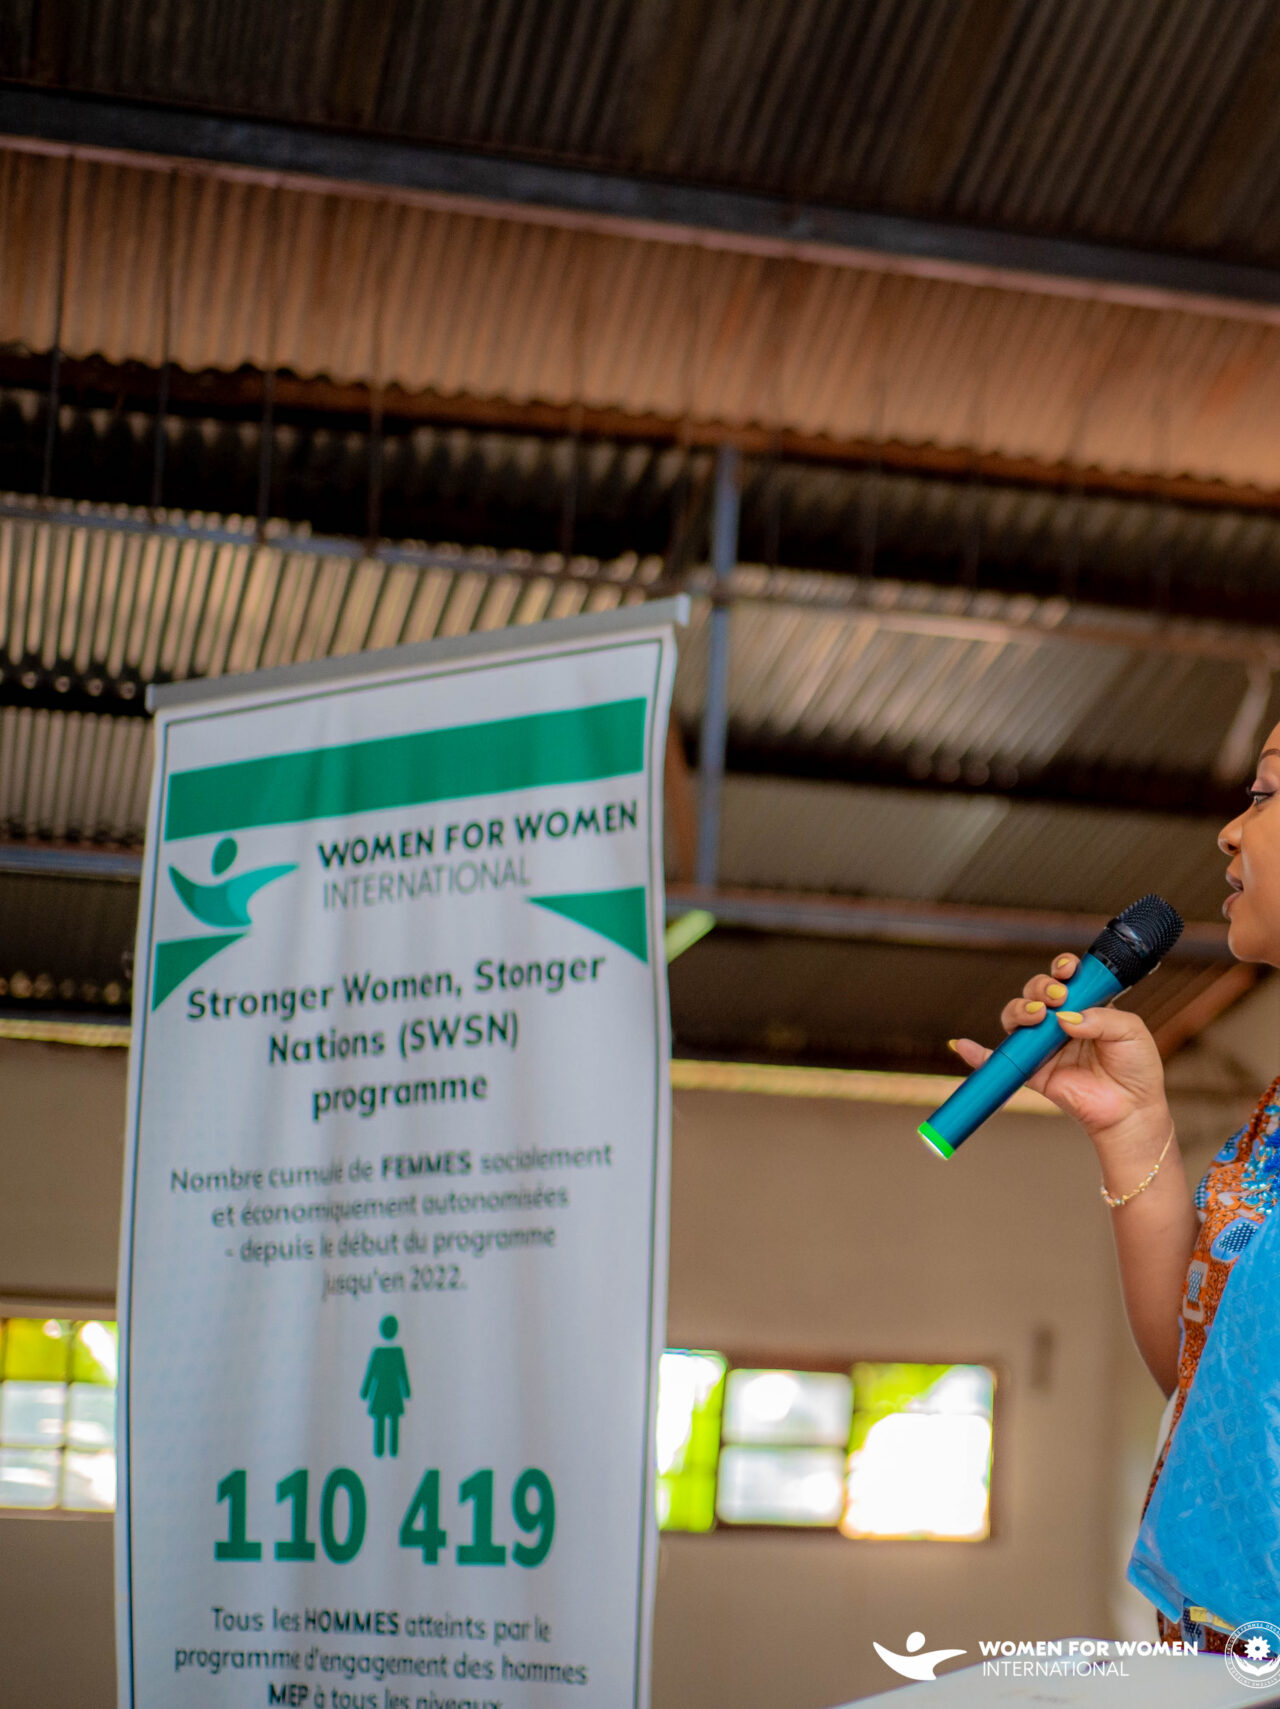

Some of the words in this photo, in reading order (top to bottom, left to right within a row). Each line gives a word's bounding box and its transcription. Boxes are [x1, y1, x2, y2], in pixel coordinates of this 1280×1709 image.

[319, 826, 434, 868] WOMEN
[445, 820, 503, 854] FOR
[516, 801, 638, 844] WOMEN
[322, 856, 530, 911] INTERNATIONAL
[187, 984, 334, 1023] Stronger
[342, 970, 463, 1004] Women,
[476, 953, 606, 994] Stonger
[268, 1027, 385, 1065] Nations
[399, 1012, 518, 1060] (SWSN)
[312, 1074, 488, 1121] programme
[171, 1165, 263, 1192] Nombre
[348, 1156, 374, 1183] de
[381, 1149, 472, 1180] FEMMES
[480, 1143, 613, 1175] socialement
[211, 1204, 236, 1228] et
[240, 1194, 418, 1226] économiquement
[240, 1234, 316, 1267] depuis
[320, 1230, 334, 1258] le
[337, 1228, 399, 1257] début
[403, 1226, 428, 1255] du
[433, 1226, 556, 1259] programme
[410, 1263, 468, 1292] 2022.
[213, 1466, 367, 1565] 110
[399, 1466, 557, 1568] 419
[211, 1605, 264, 1632] Tous
[272, 1605, 301, 1632] les
[304, 1606, 400, 1636] HOMMES
[404, 1611, 487, 1640] atteints
[493, 1619, 531, 1646] par
[535, 1614, 552, 1643] le
[175, 1648, 300, 1675] programme
[304, 1646, 448, 1681] d'engagement
[453, 1651, 495, 1680] des
[502, 1653, 589, 1686] hommes
[268, 1682, 309, 1708] MEP
